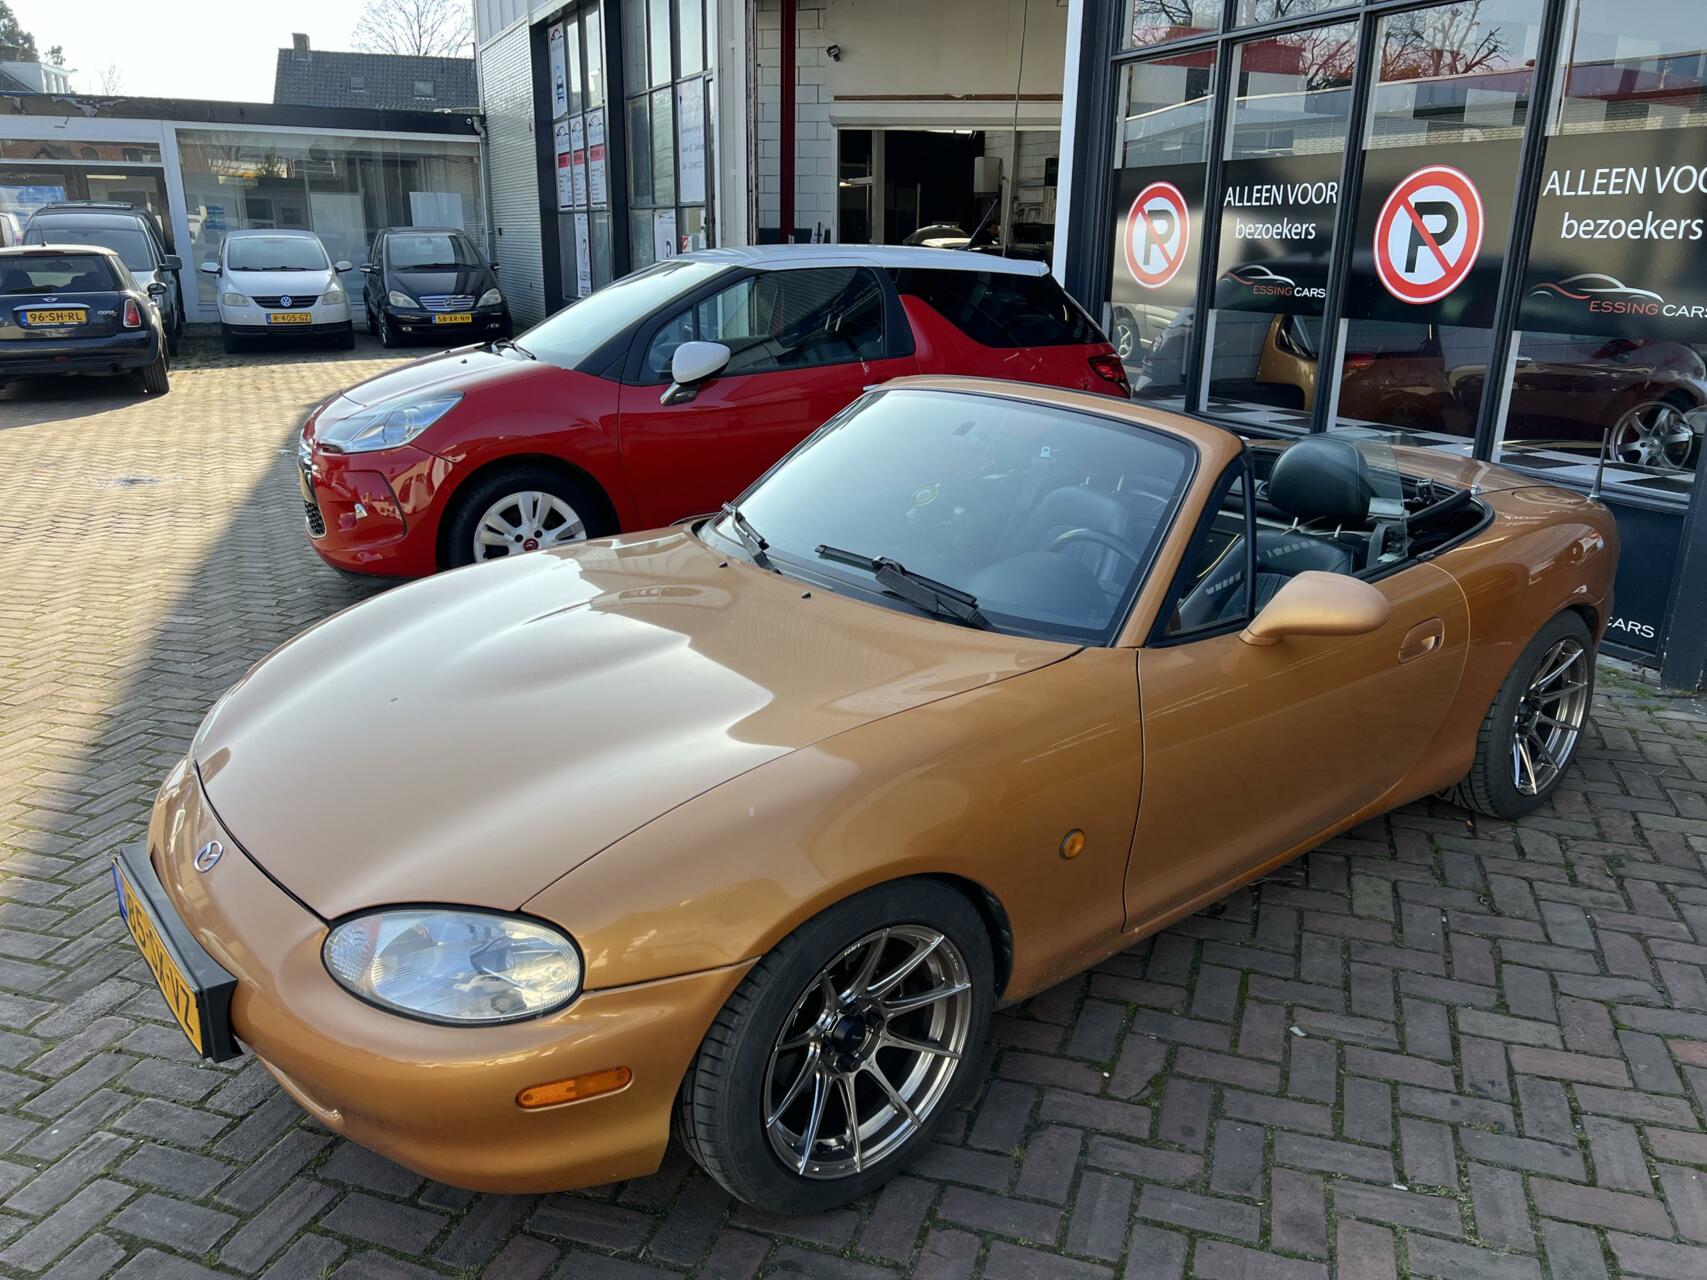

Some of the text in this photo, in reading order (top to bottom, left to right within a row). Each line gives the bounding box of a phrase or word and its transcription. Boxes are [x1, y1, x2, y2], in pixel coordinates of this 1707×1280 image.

[1543, 167, 1648, 197] ALLEEN
[1223, 182, 1338, 207] ALLEEN VOOR
[1235, 217, 1317, 240] bezoekers
[1560, 211, 1704, 240] bezoekers
[1253, 285, 1326, 298] ESSING CARS
[30, 312, 83, 322] 96-SH-RL
[1589, 301, 1659, 316] ESSING
[273, 314, 309, 323] R-405-GZ
